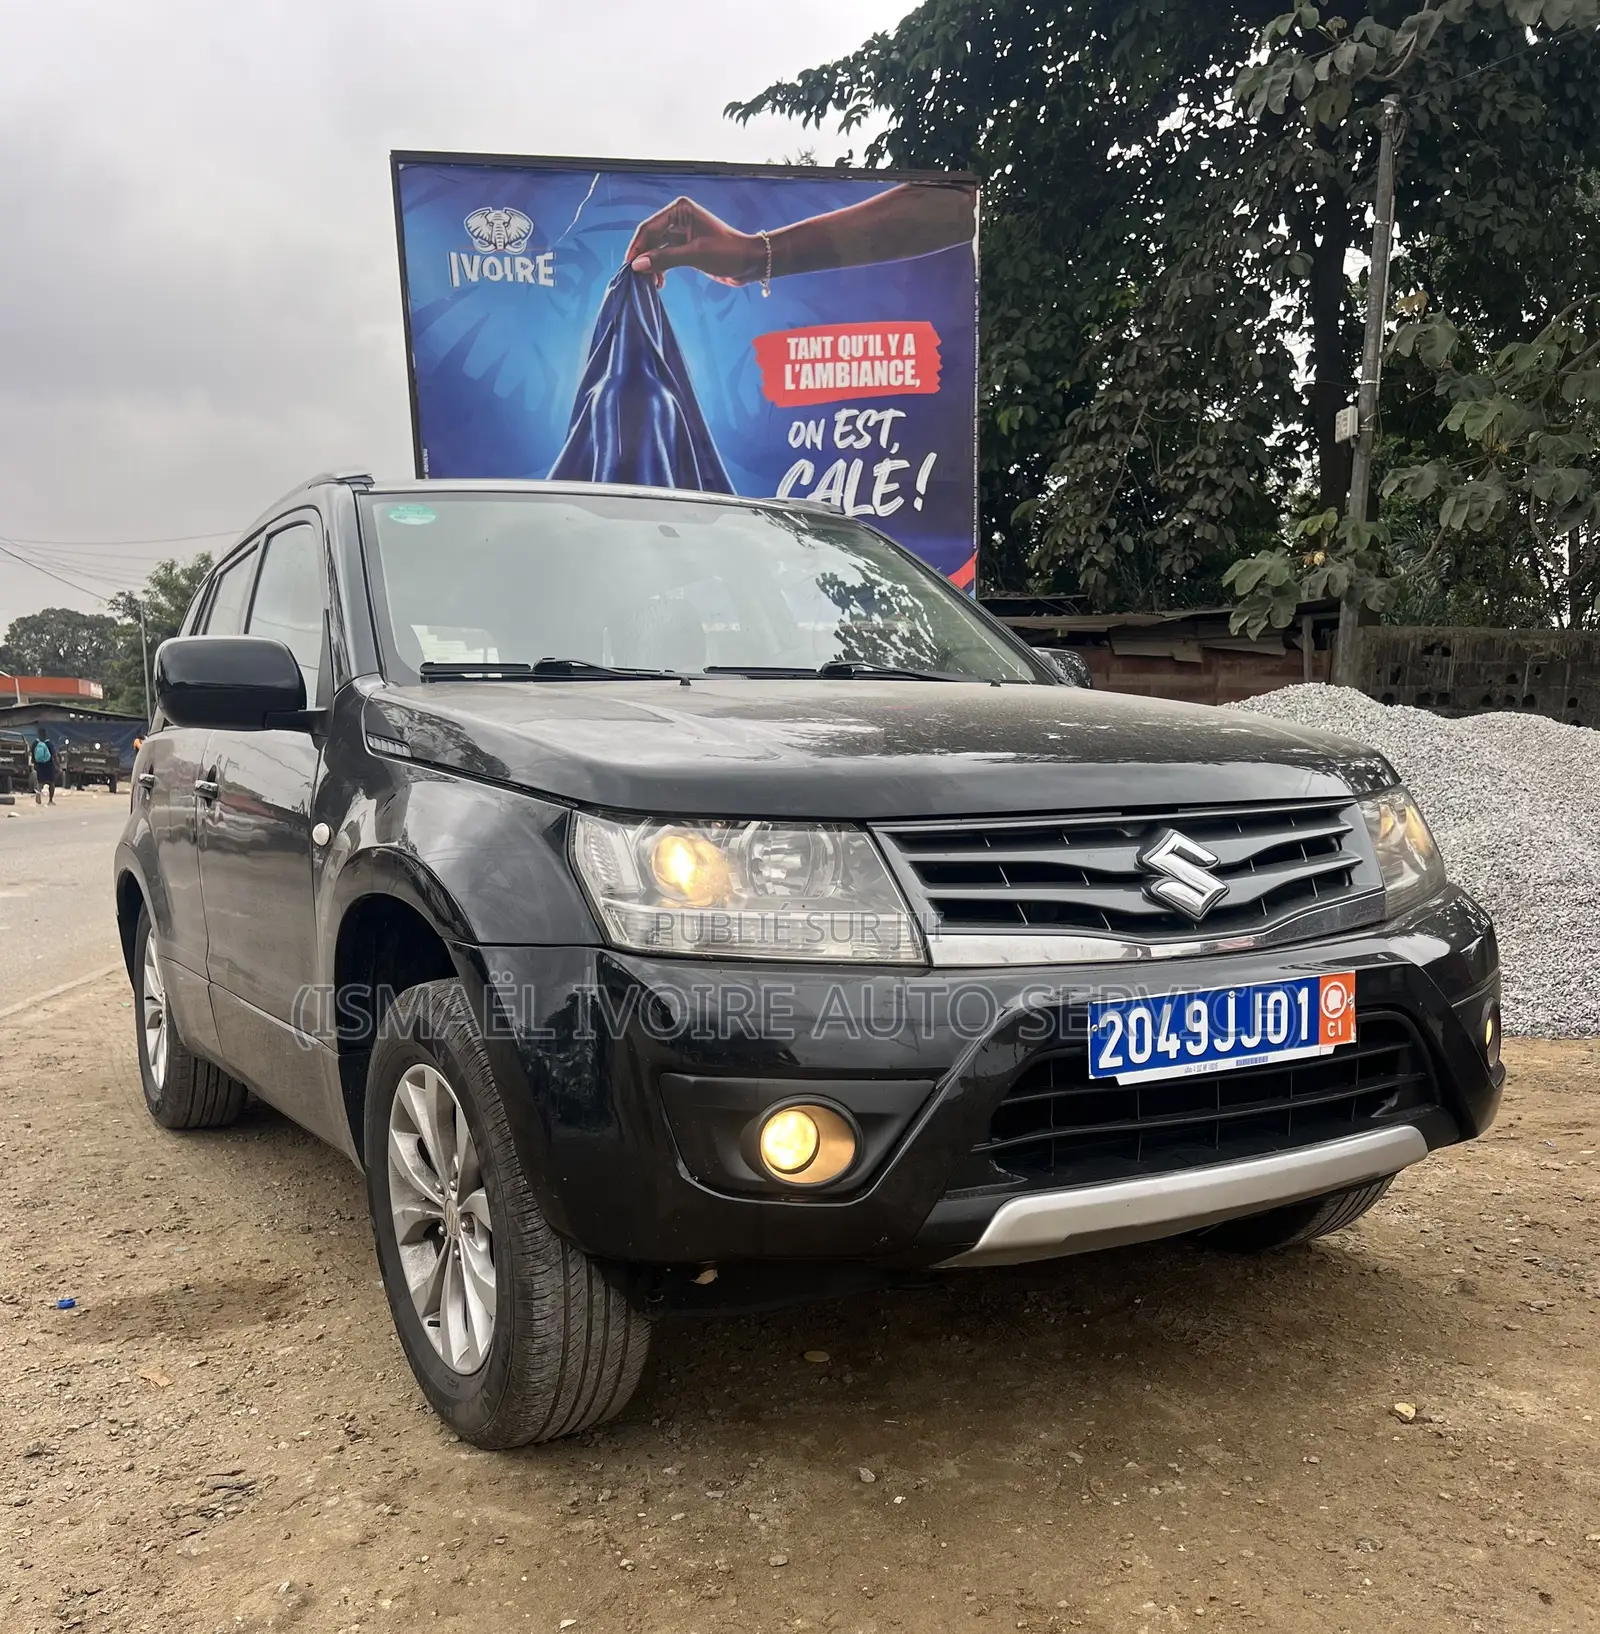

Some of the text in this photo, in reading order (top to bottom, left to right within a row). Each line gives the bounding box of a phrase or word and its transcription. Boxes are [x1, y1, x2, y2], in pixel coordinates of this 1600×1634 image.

[447, 251, 556, 287] IVOIRE
[786, 333, 916, 360] TANT QU'IL Y A
[784, 359, 921, 391] L'AMBIANCE,
[788, 418, 825, 451] ON
